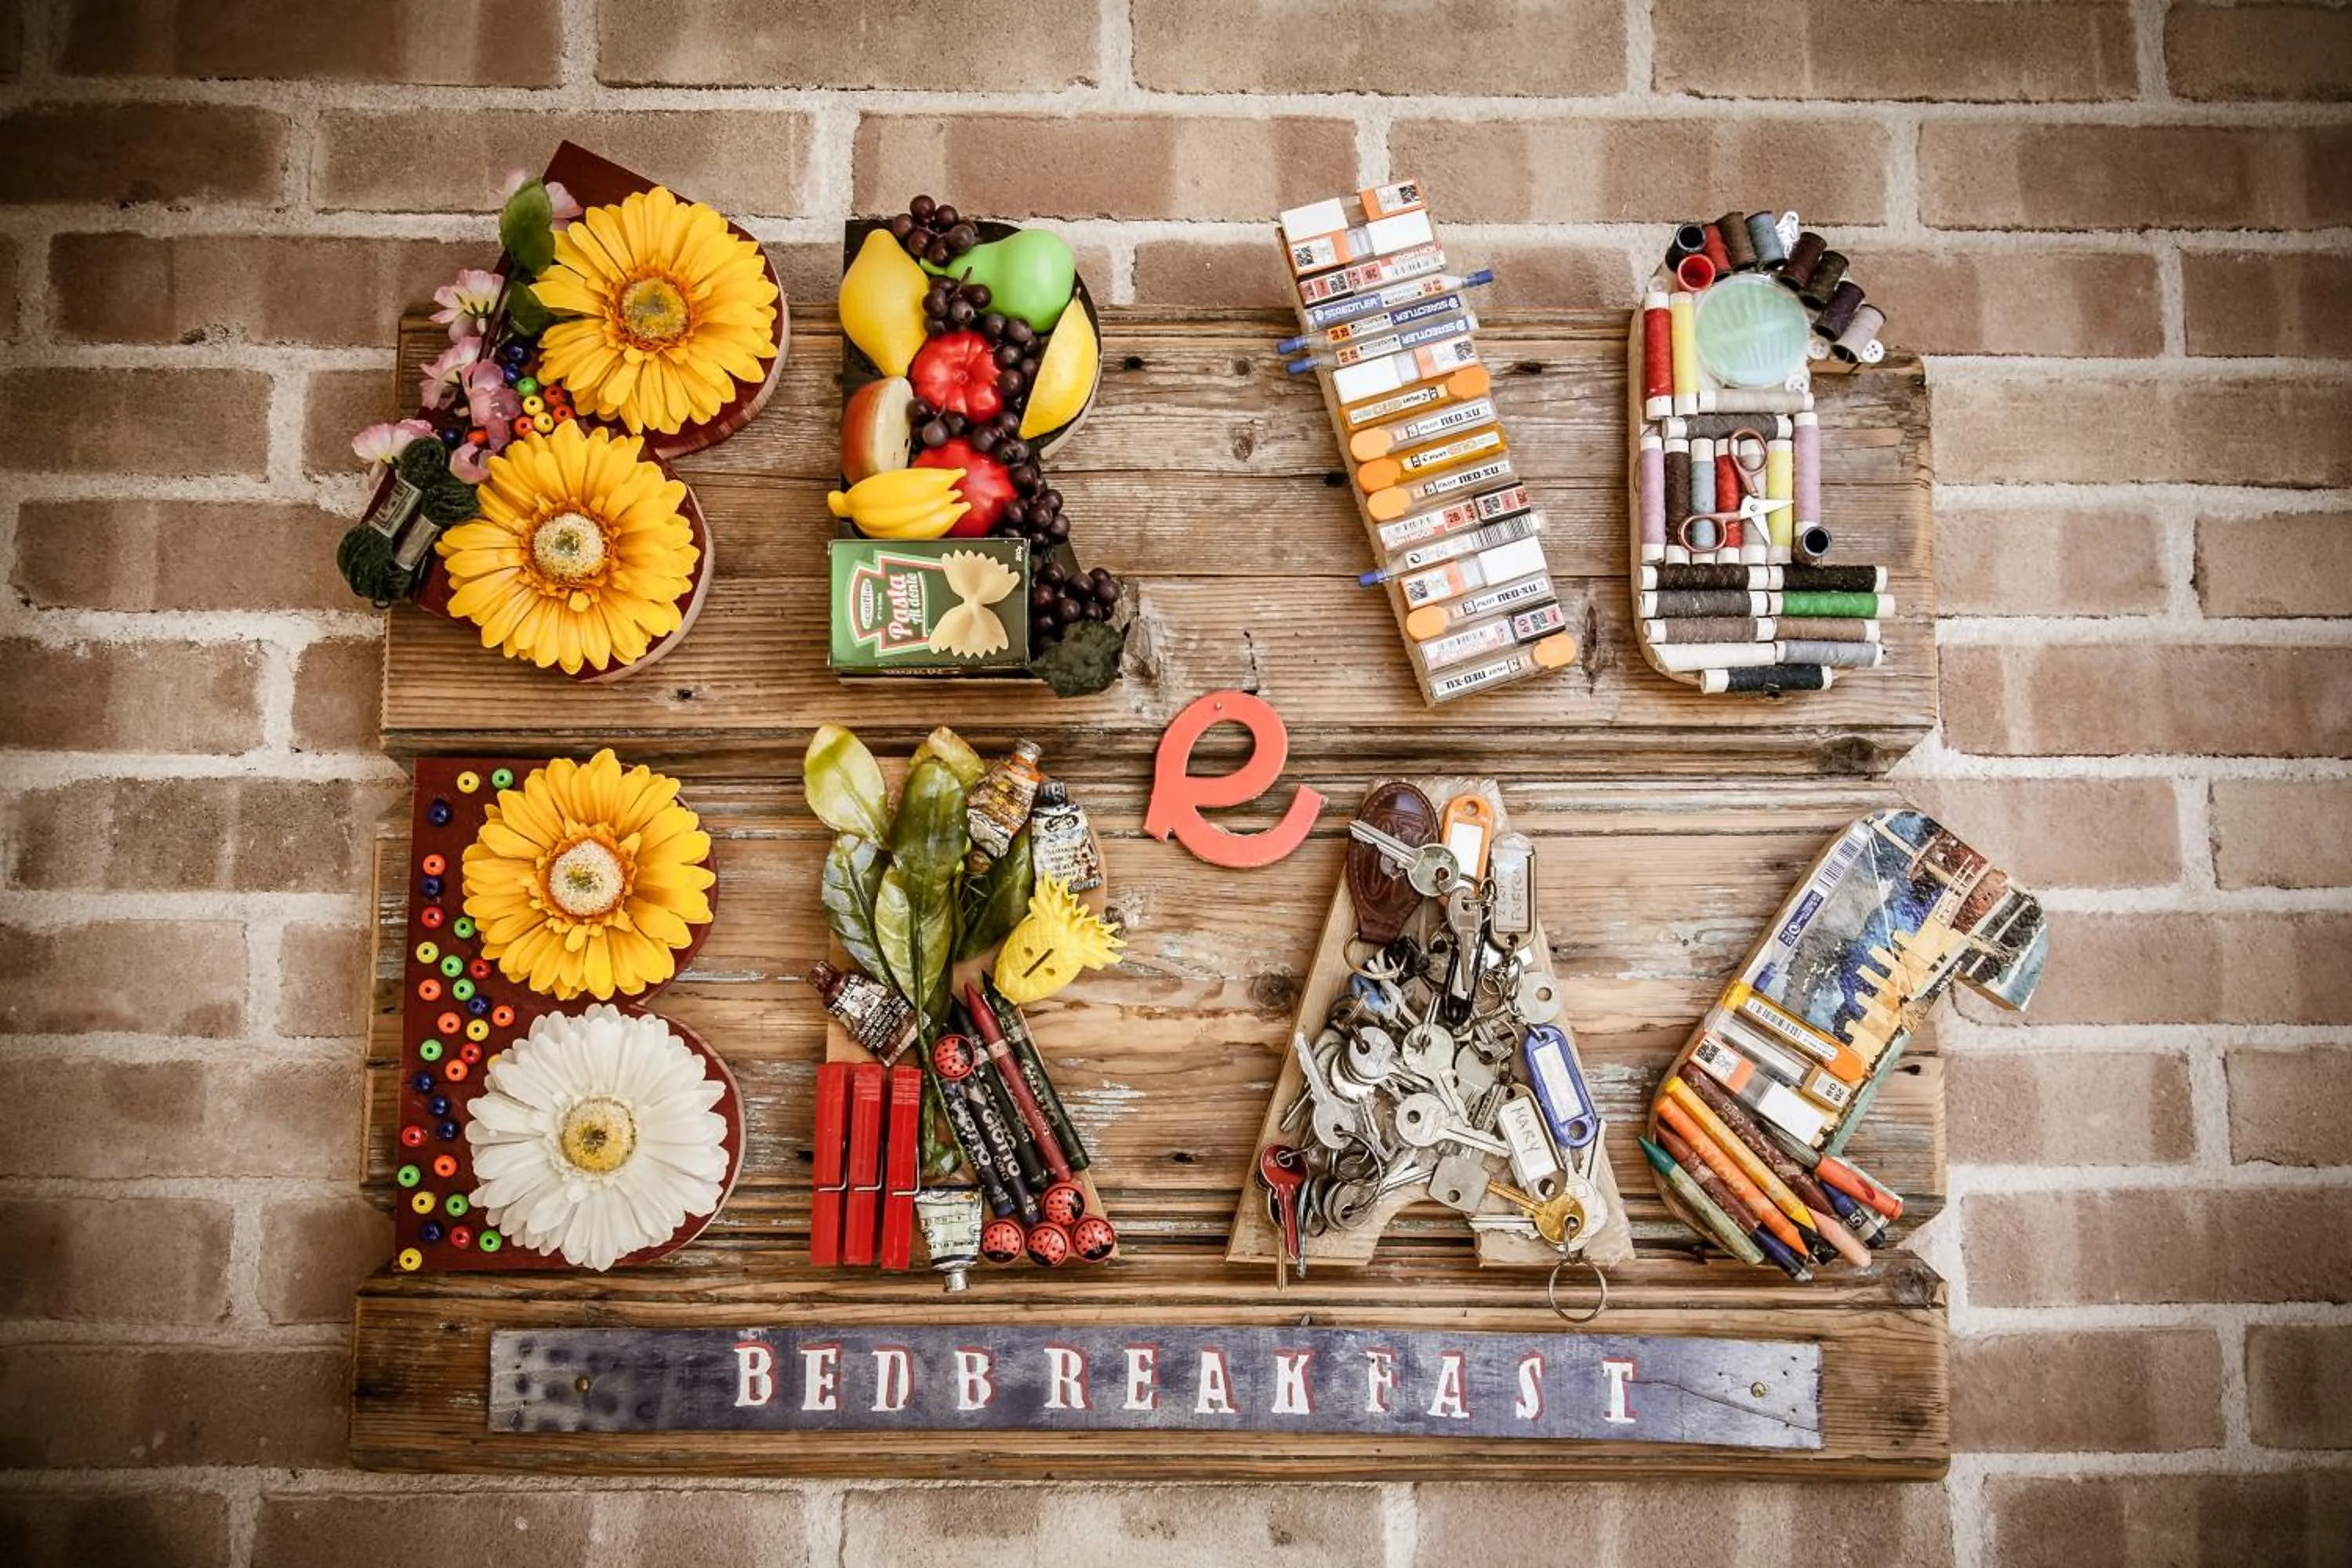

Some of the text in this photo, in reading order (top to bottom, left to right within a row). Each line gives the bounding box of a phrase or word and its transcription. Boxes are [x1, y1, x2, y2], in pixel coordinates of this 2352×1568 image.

[887, 573, 913, 640] Pasta
[906, 572, 920, 606] dente
[979, 1107, 1022, 1179] GIOTTO
